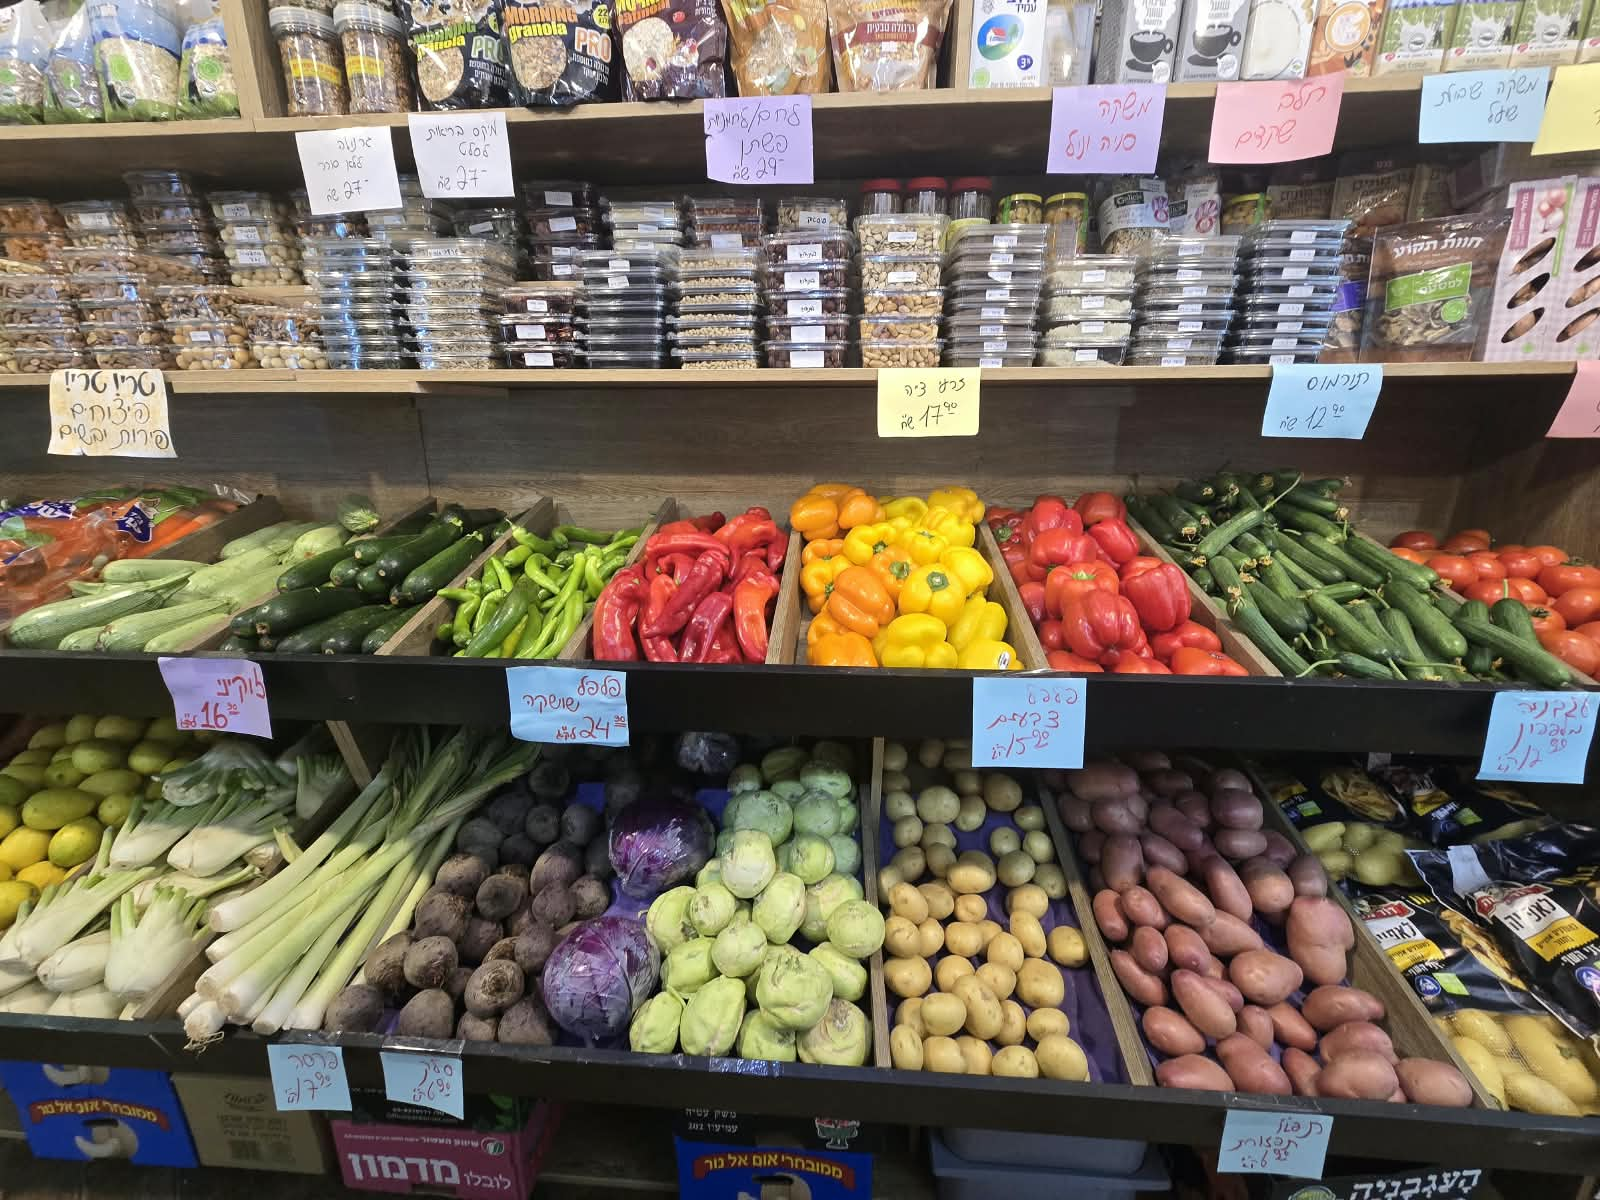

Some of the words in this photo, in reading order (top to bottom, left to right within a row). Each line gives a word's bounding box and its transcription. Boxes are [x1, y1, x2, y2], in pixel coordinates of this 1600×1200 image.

[504, 6, 578, 25] MORNING
[508, 20, 568, 45] granola
[866, 23, 890, 35] טבעית
[891, 22, 916, 34] גרנולה
[574, 26, 612, 63] PRO
[1497, 77, 1539, 98] משקה
[1098, 91, 1153, 125] משקה
[1277, 86, 1326, 113] חלב
[1488, 101, 1519, 123] שועל
[472, 119, 498, 141] מיקס
[1232, 119, 1297, 150] שקדים
[459, 140, 490, 158] לסלט
[740, 132, 788, 165] פשתן
[1100, 133, 1137, 153] סויה
[1392, 240, 1438, 260] תקוע
[1440, 236, 1484, 250] חוות
[65, 371, 107, 393] טרי!
[113, 371, 155, 396] טרי!
[1307, 372, 1370, 391] תורמוס
[71, 398, 150, 425] פיצוחים
[60, 424, 108, 445] יבשים
[111, 429, 169, 450] פירות
[577, 675, 621, 697] פלפל
[1027, 685, 1078, 704] פלפל
[522, 694, 580, 714] שושקה
[420, 1059, 454, 1087] סלק
[705, 1159, 725, 1171] נור
[727, 1153, 748, 1167] אל
[752, 1153, 781, 1168] אום
[781, 1154, 843, 1180] ממובחרי
